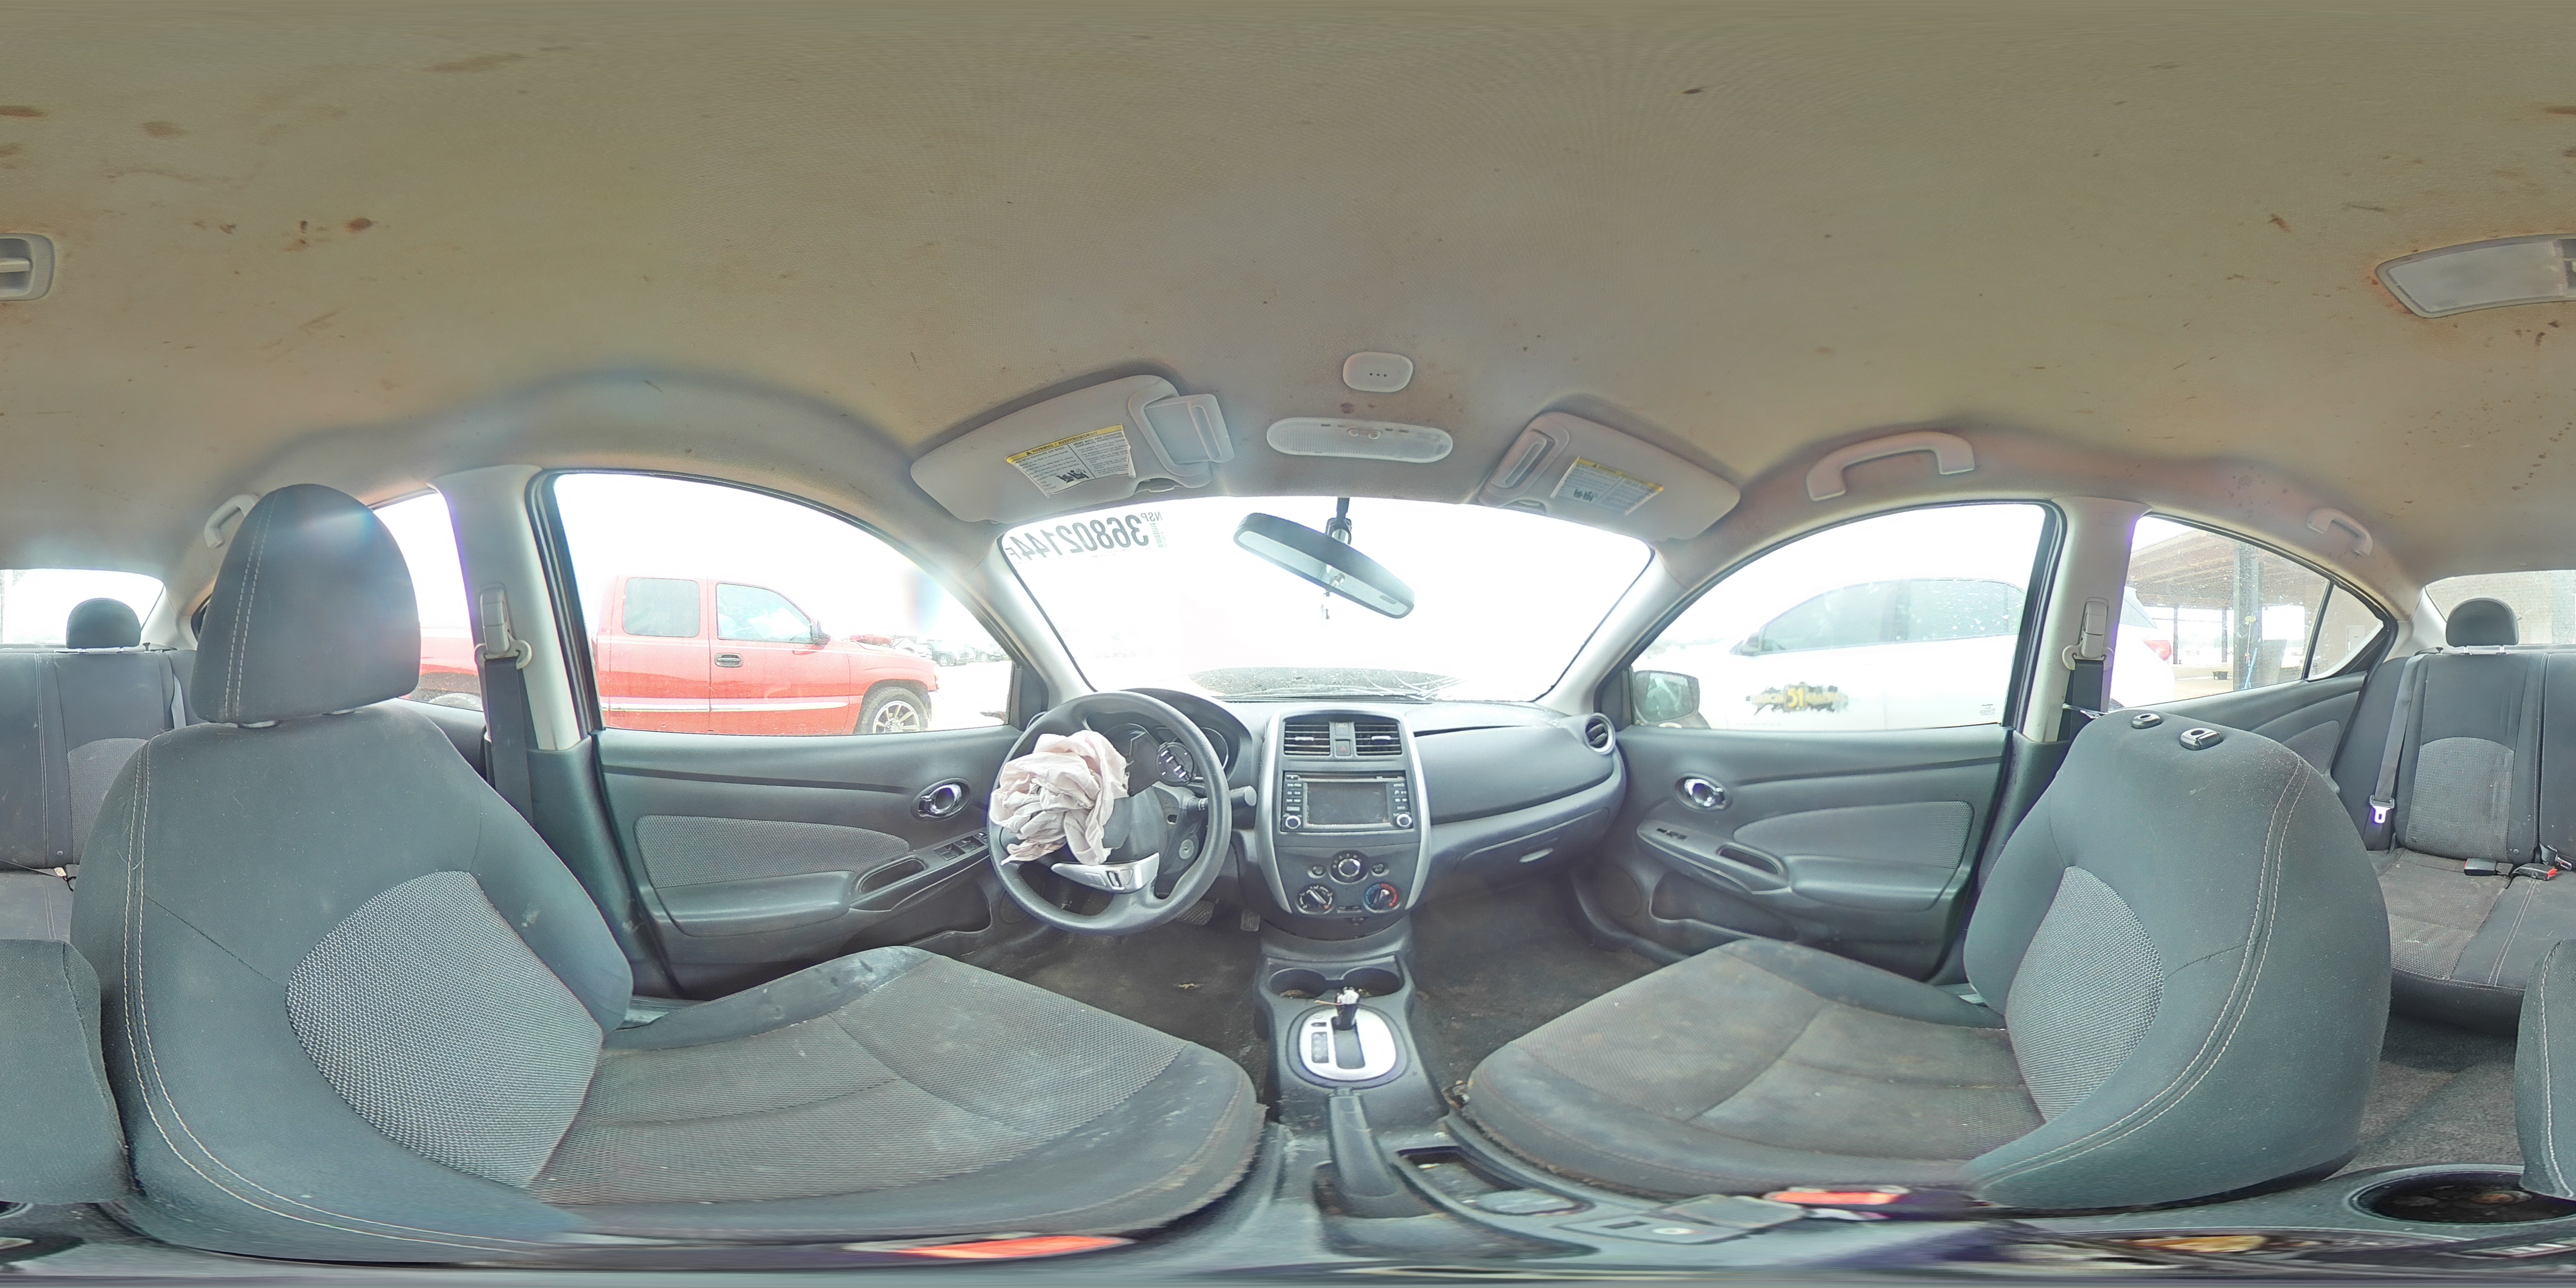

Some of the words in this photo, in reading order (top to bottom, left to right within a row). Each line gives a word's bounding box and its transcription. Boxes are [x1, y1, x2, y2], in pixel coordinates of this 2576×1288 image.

[1031, 444, 1054, 453] WARNING
[1058, 431, 1098, 445] AVERTISSEMENT
[1787, 688, 1804, 708] 51
